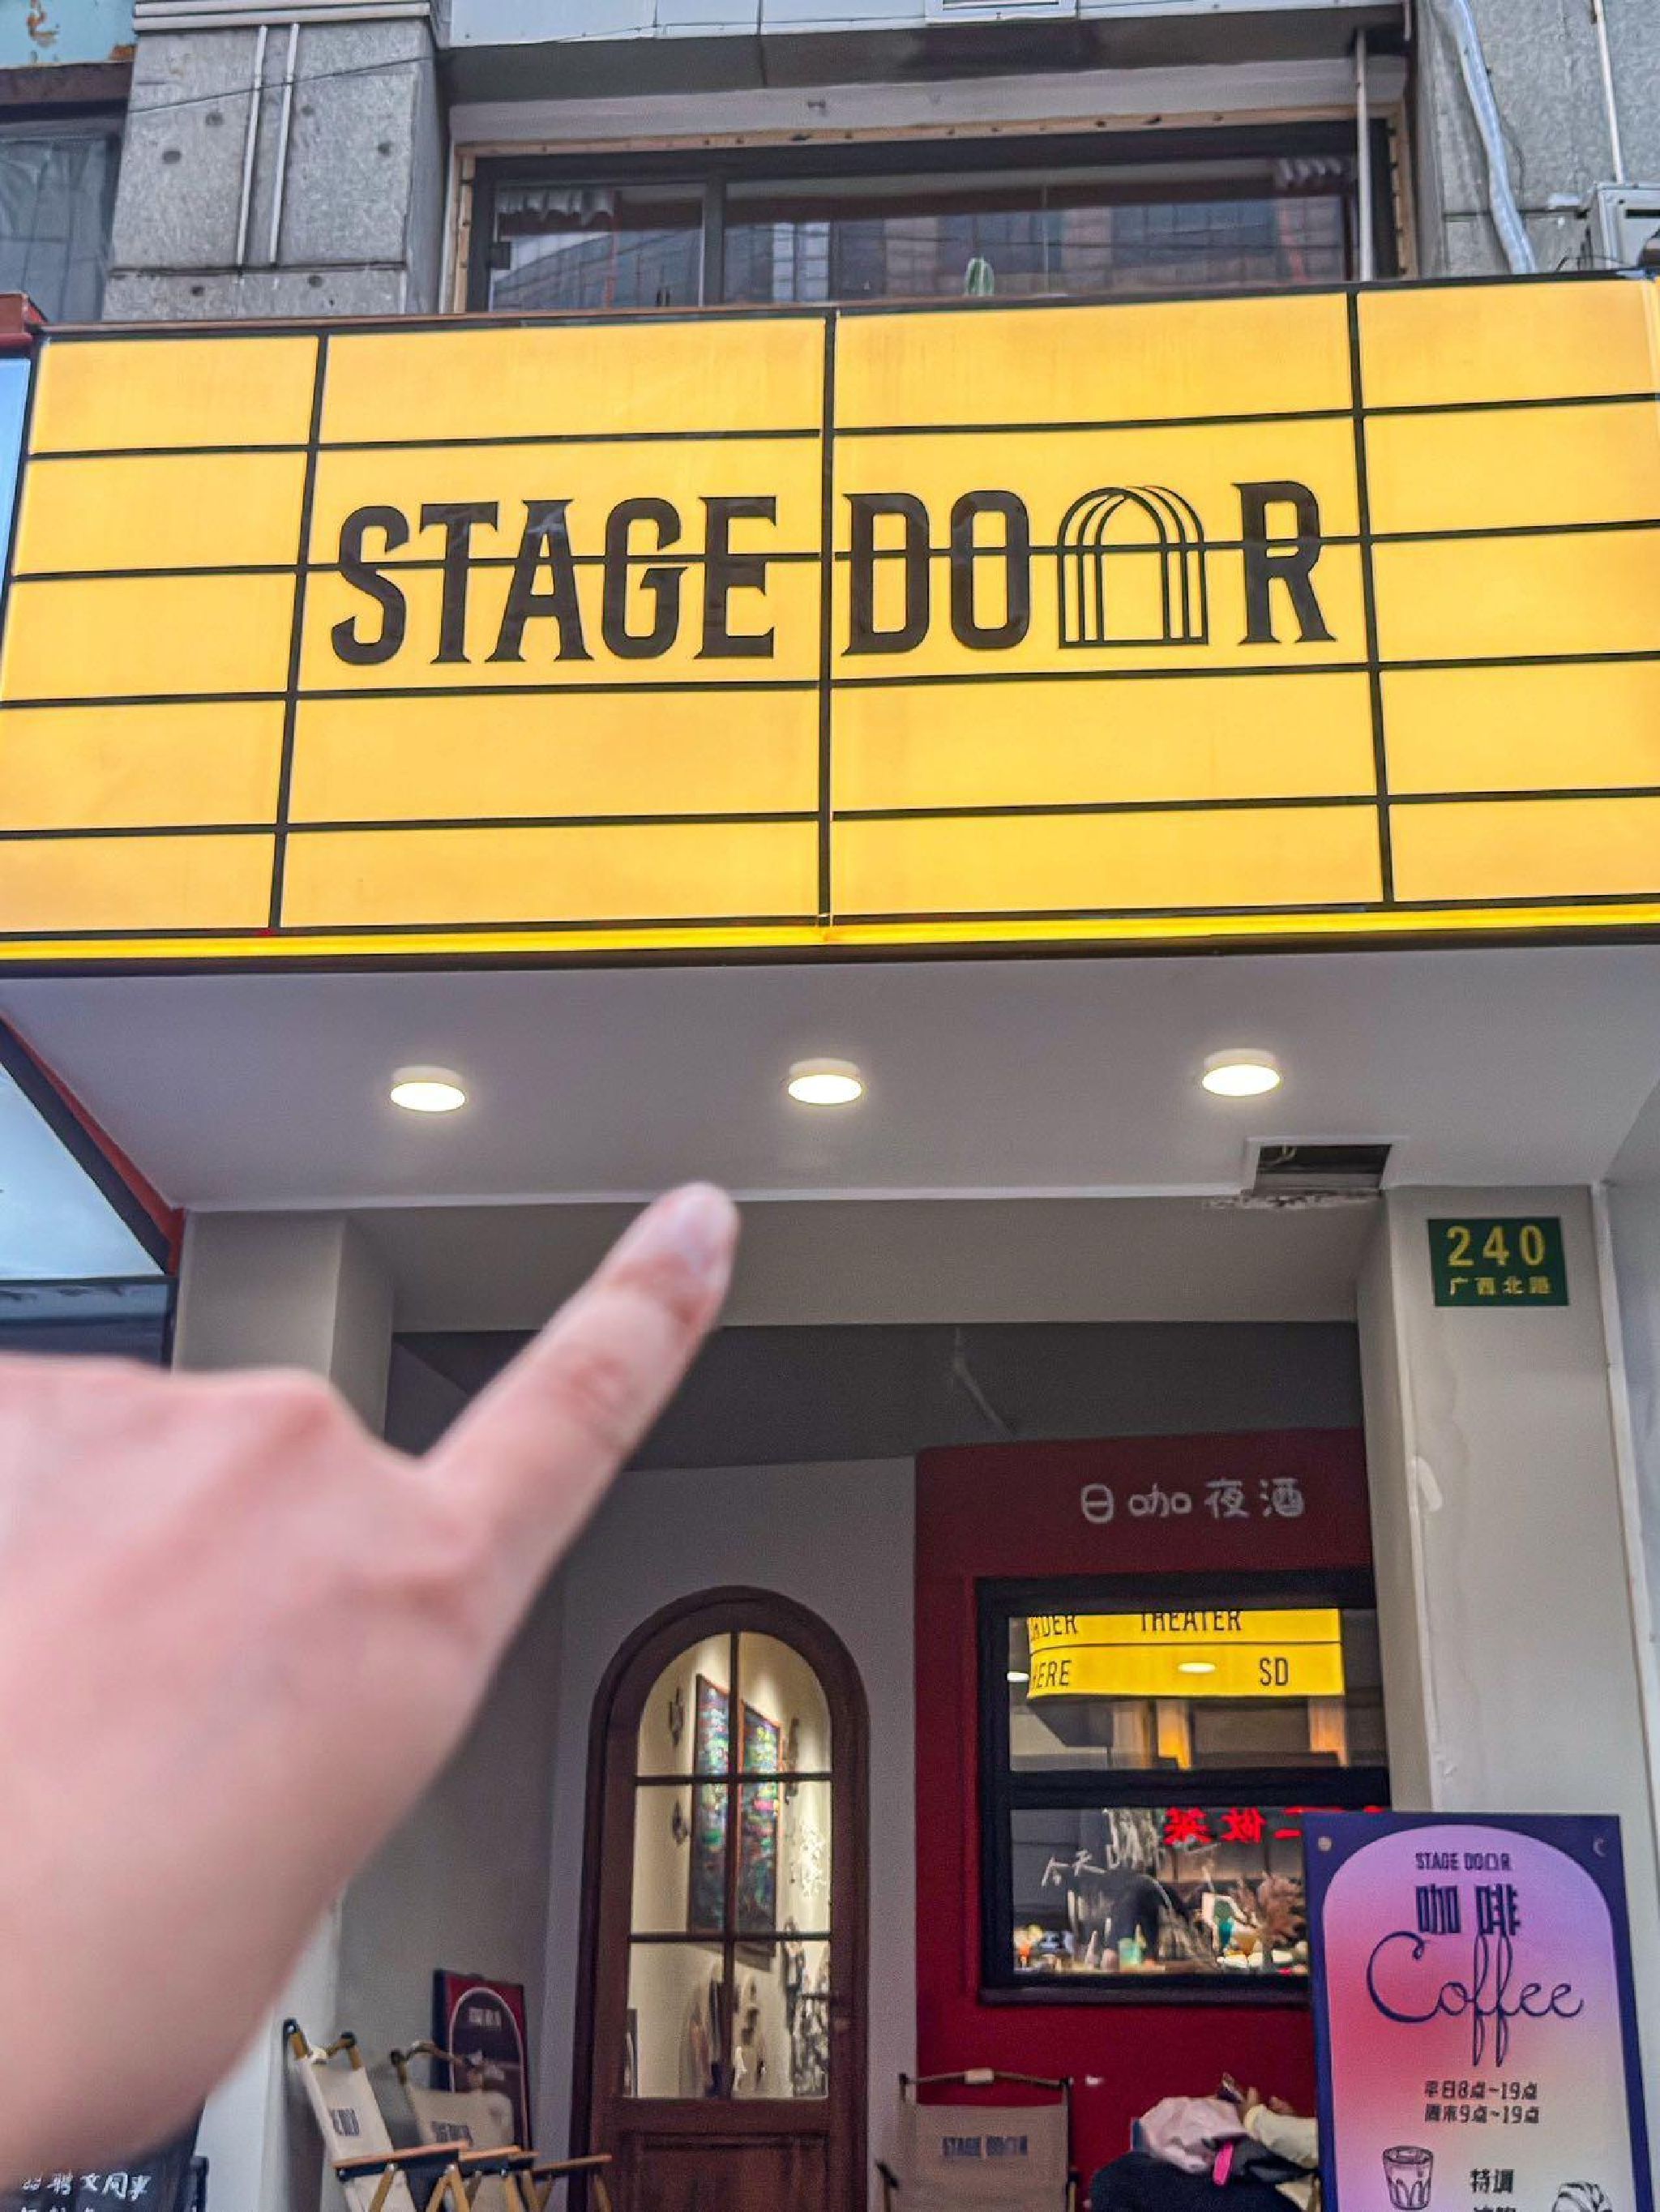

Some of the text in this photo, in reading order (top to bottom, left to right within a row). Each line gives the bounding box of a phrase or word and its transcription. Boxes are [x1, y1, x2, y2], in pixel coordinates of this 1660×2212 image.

[332, 497, 778, 665] STAGE
[1447, 1225, 1547, 1266] 240
[1080, 1478, 1305, 1524] 日咖夜酒
[1140, 1610, 1243, 1631] THEATER
[1259, 1658, 1290, 1686] SD
[1415, 1852, 1459, 1871] STAGE
[1415, 1883, 1521, 1936] 咖啡
[1366, 1931, 1584, 2068] Coffee
